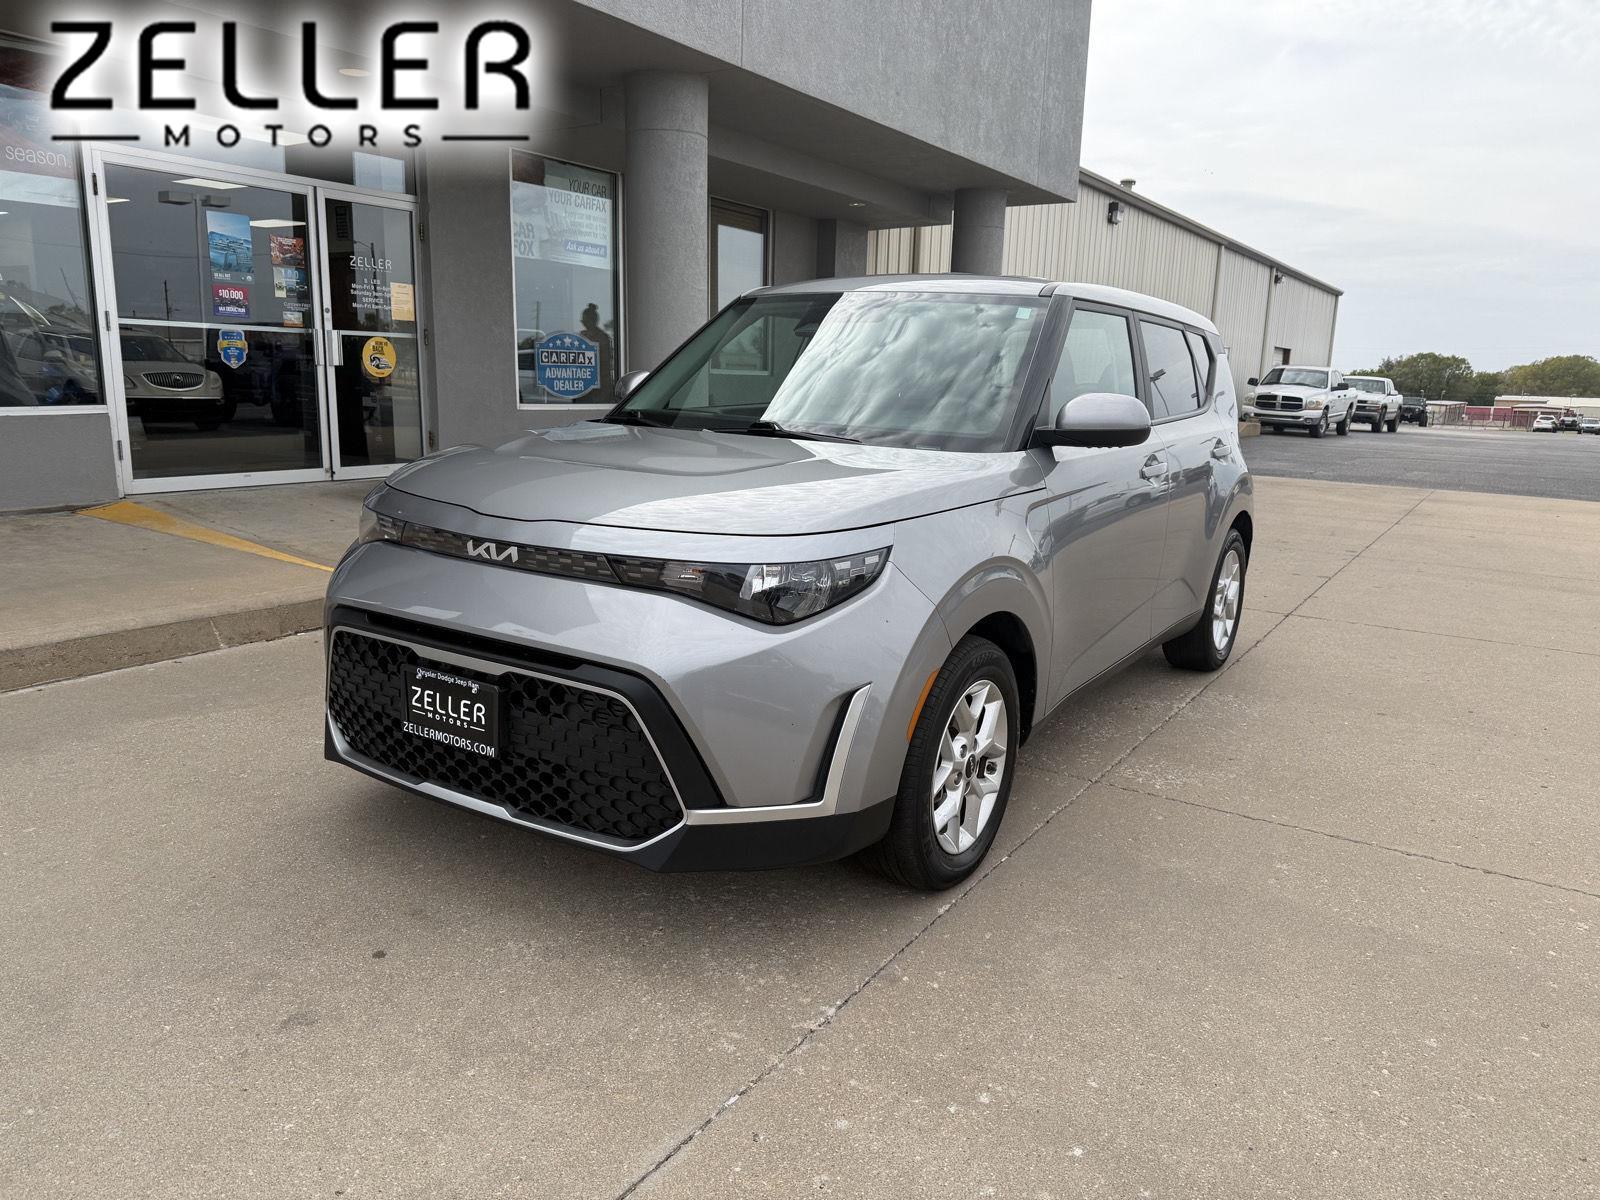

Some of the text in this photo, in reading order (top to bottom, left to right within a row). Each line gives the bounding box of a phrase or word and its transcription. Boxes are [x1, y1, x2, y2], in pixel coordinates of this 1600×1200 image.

[568, 178, 607, 198] YOUR CAR
[548, 189, 607, 212] YOUR CARFAX
[350, 255, 392, 269] ZELLER
[541, 351, 593, 365] CARFAX
[545, 367, 592, 379] ADVANTAGE
[553, 379, 584, 391] DEALER
[467, 540, 518, 563] KIA
[437, 672, 455, 684] Dodge
[455, 677, 467, 687] Jeep
[411, 685, 486, 725] ZELLER
[427, 711, 468, 728] MOTORS
[403, 721, 496, 758] ZELLERMOTORS.COM
